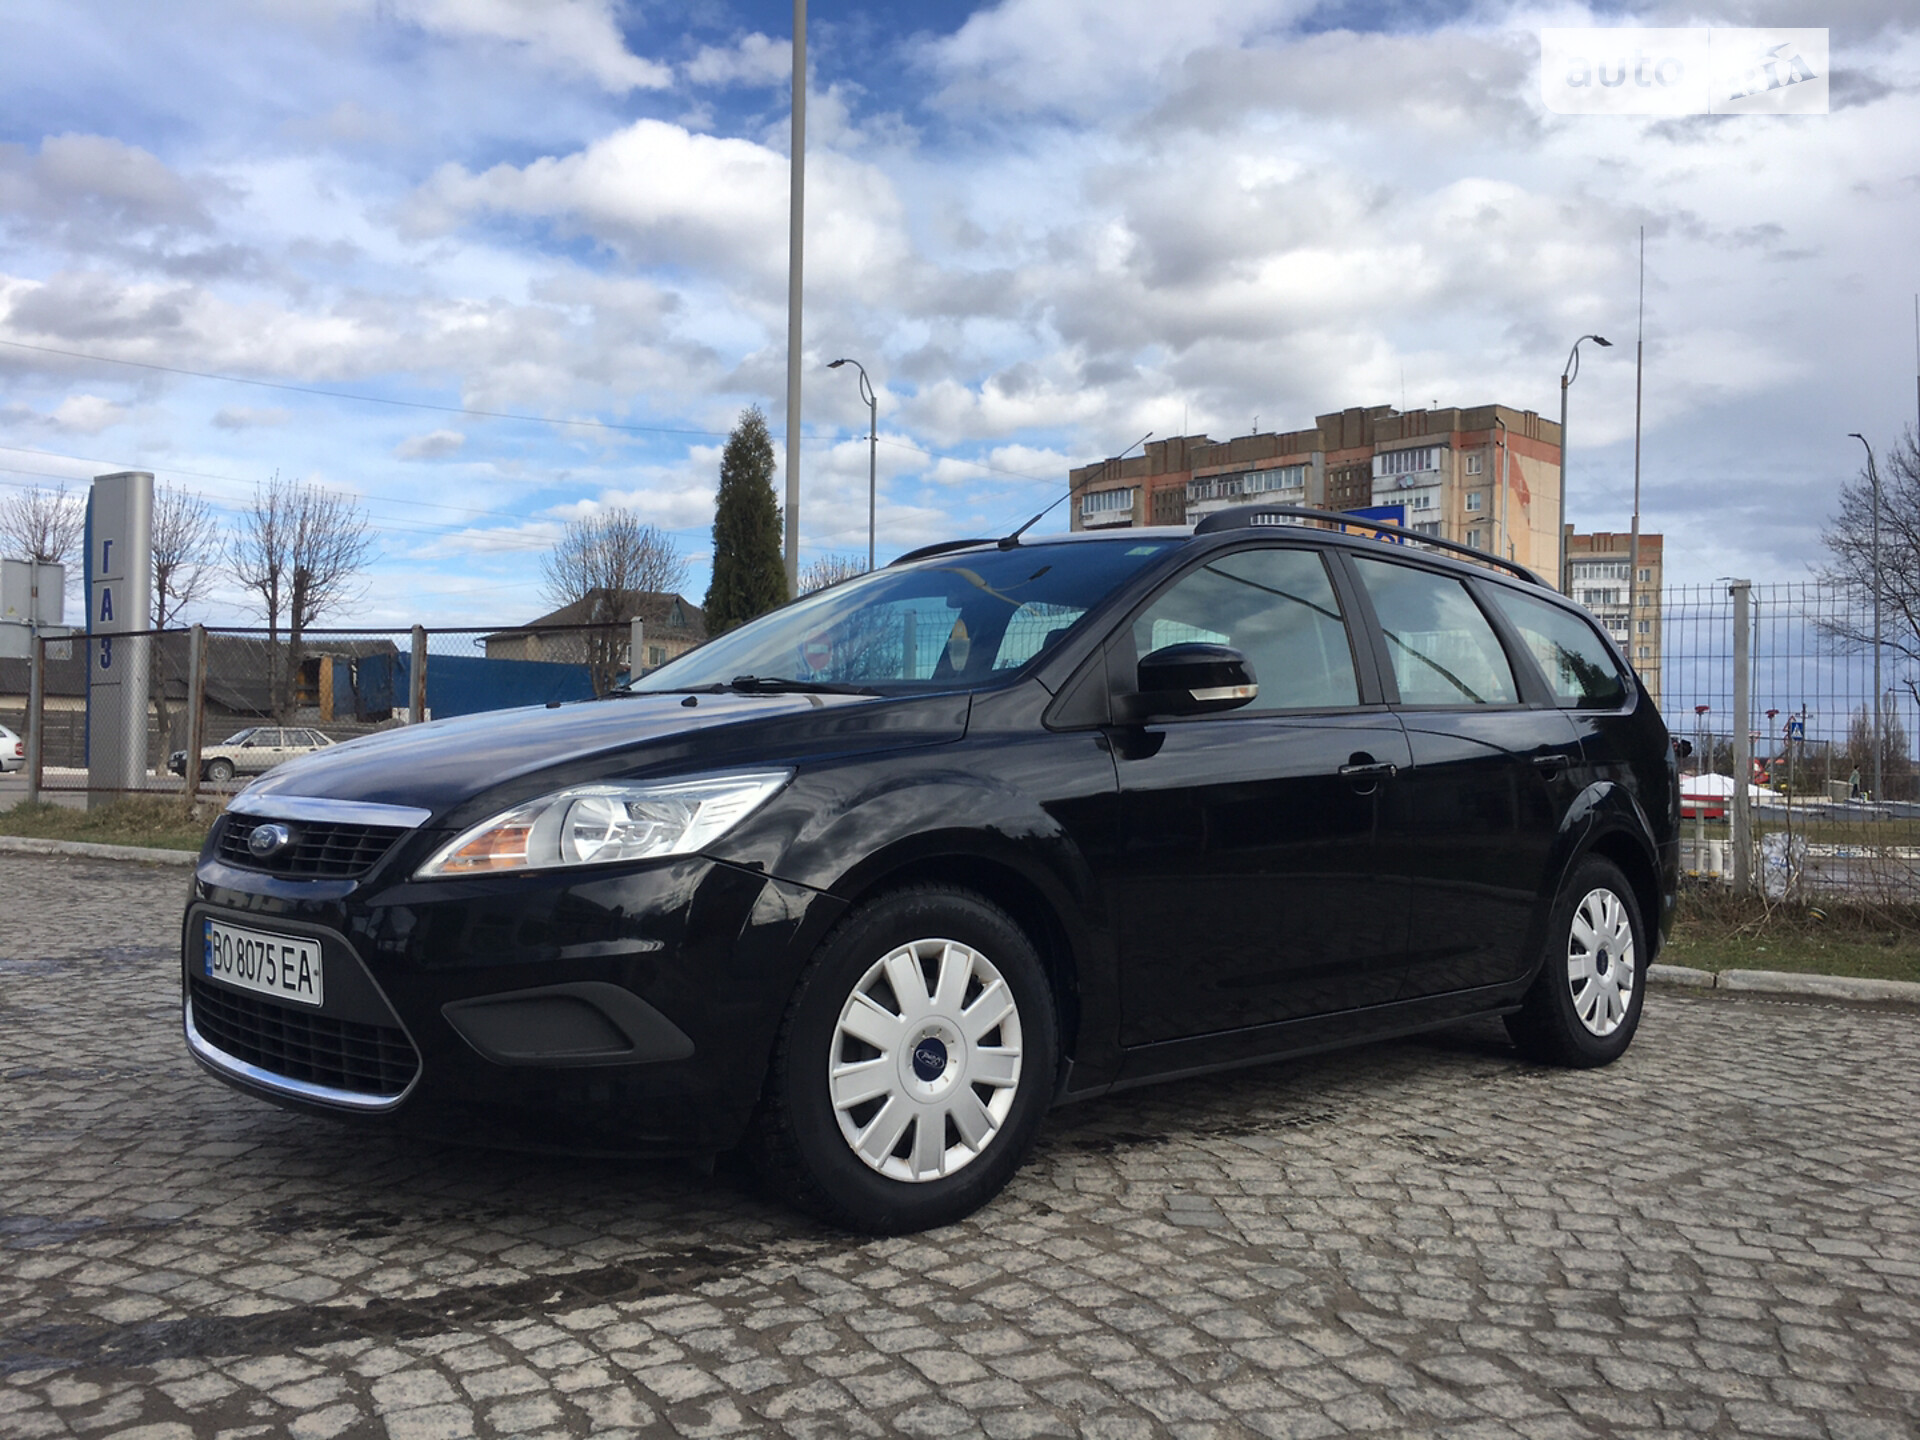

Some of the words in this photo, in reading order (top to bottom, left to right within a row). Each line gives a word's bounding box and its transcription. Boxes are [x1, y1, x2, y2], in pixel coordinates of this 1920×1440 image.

[213, 930, 233, 973] BO
[237, 937, 276, 986] 8075
[282, 945, 313, 994] EA
